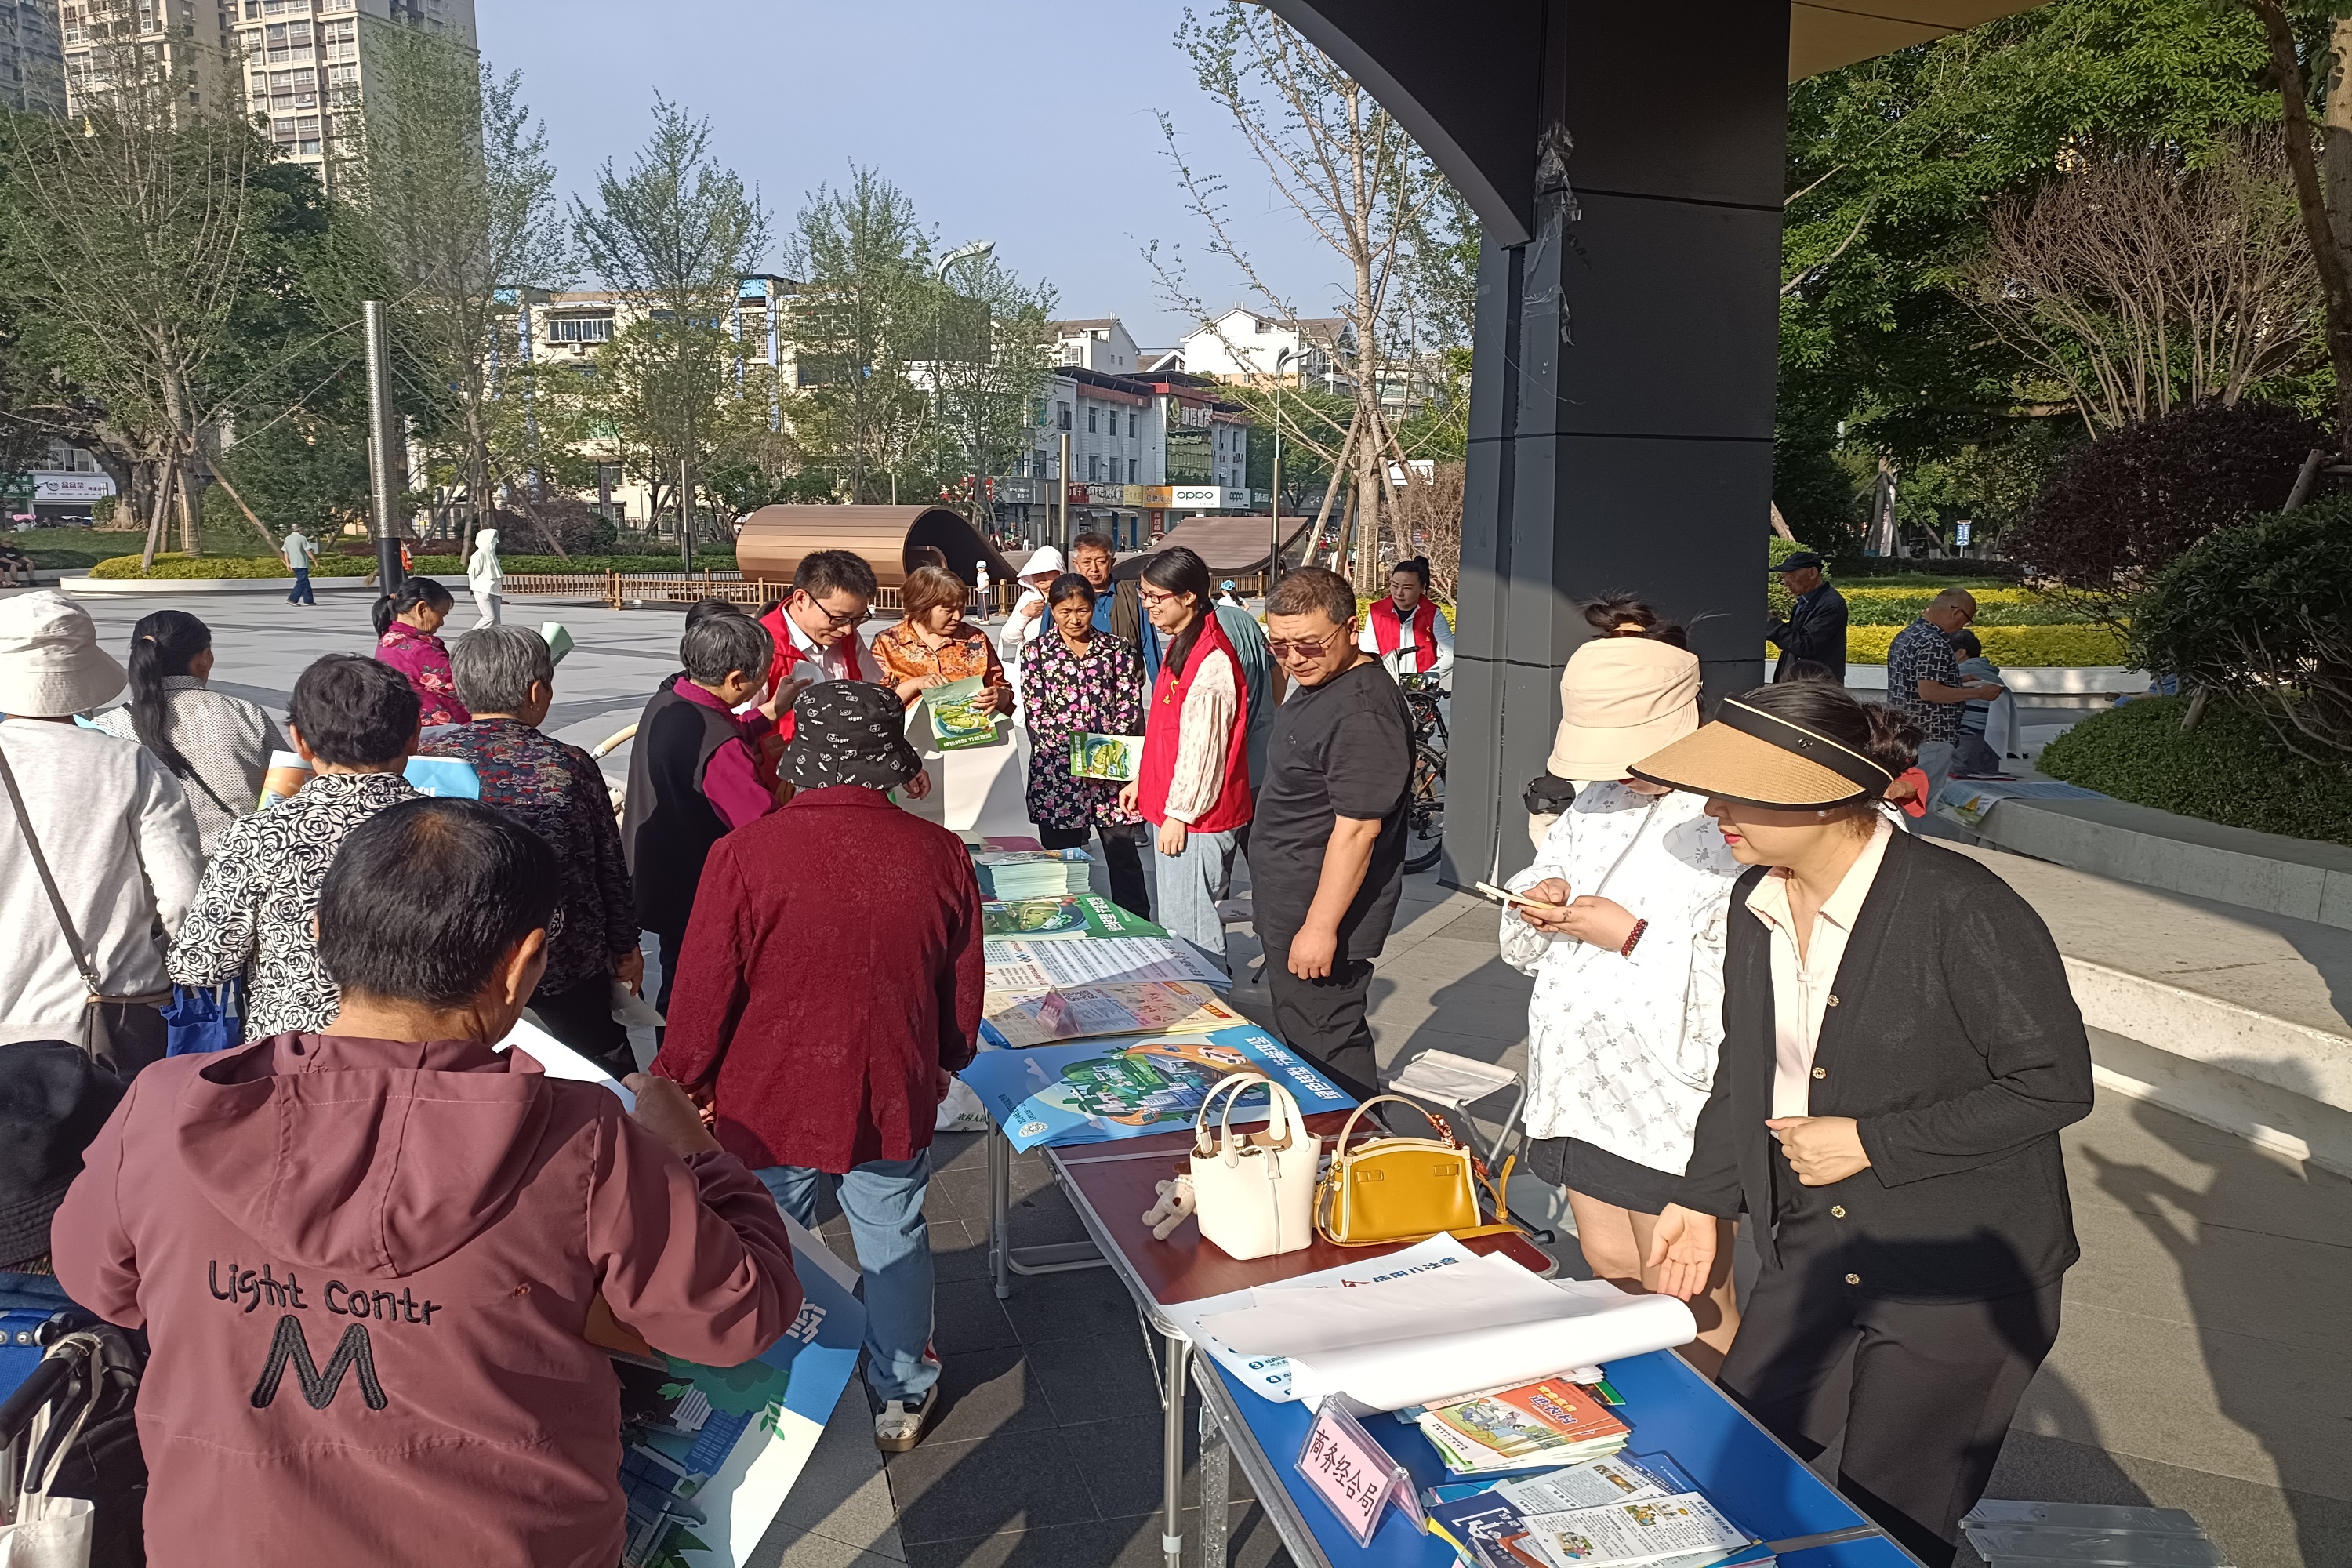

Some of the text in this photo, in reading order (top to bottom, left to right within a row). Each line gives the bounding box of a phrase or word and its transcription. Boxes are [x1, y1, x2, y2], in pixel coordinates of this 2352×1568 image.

[1245, 1036, 1345, 1101] 绿色转型 节能攻坚
[209, 1260, 442, 1326] Light Contr
[250, 1315, 389, 1410] M
[1529, 1394, 1579, 1425] 进农村
[1309, 1428, 1378, 1518] 商务经合局
